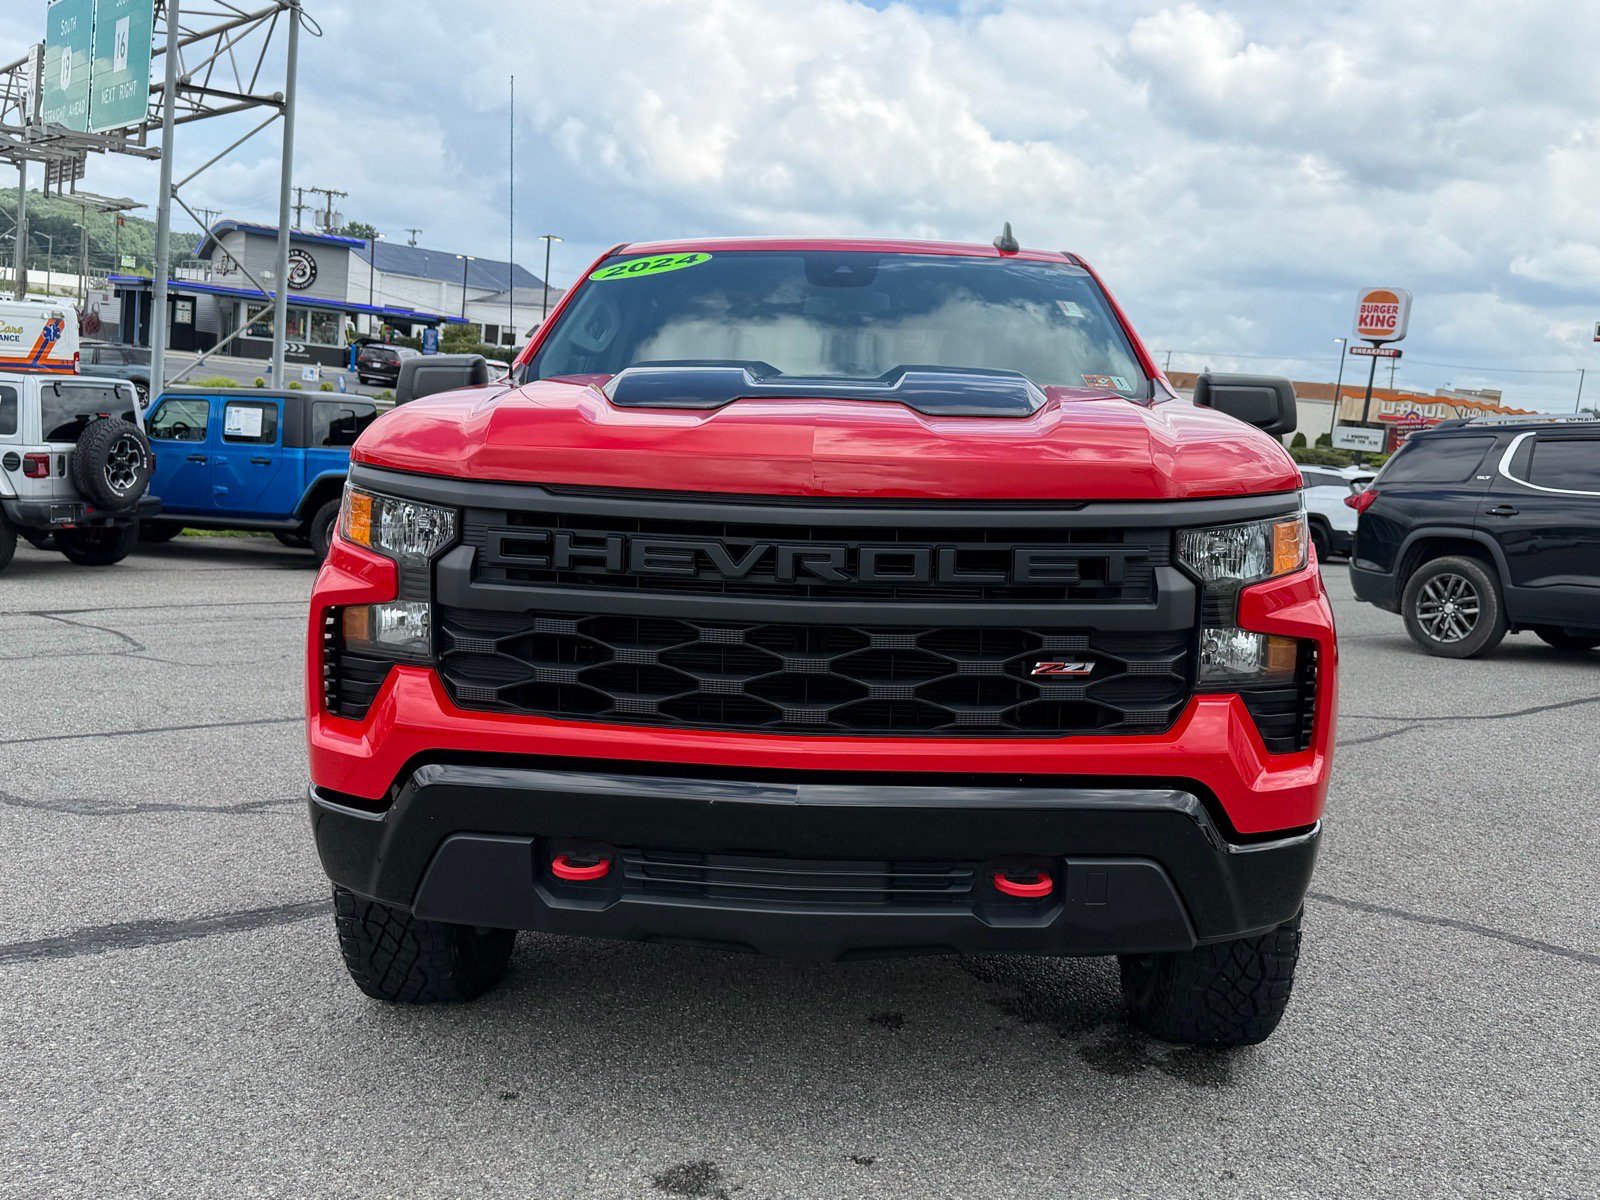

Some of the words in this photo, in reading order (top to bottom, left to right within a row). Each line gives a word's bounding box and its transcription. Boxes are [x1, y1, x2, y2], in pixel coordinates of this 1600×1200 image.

[60, 16, 77, 36] SOUTH
[116, 31, 126, 58] 16
[62, 55, 70, 82] 19
[101, 87, 116, 105] NEXT
[119, 80, 137, 100] RIGHT
[68, 99, 86, 116] AHEAD
[602, 254, 698, 278] 2024
[1360, 304, 1398, 315] BURGER
[1358, 314, 1397, 328] KING
[1351, 347, 1395, 356] BREAKFAST
[1381, 401, 1446, 419] U-HAUL
[485, 529, 1151, 586] CHEVROLET
[1030, 661, 1096, 676] Z71
